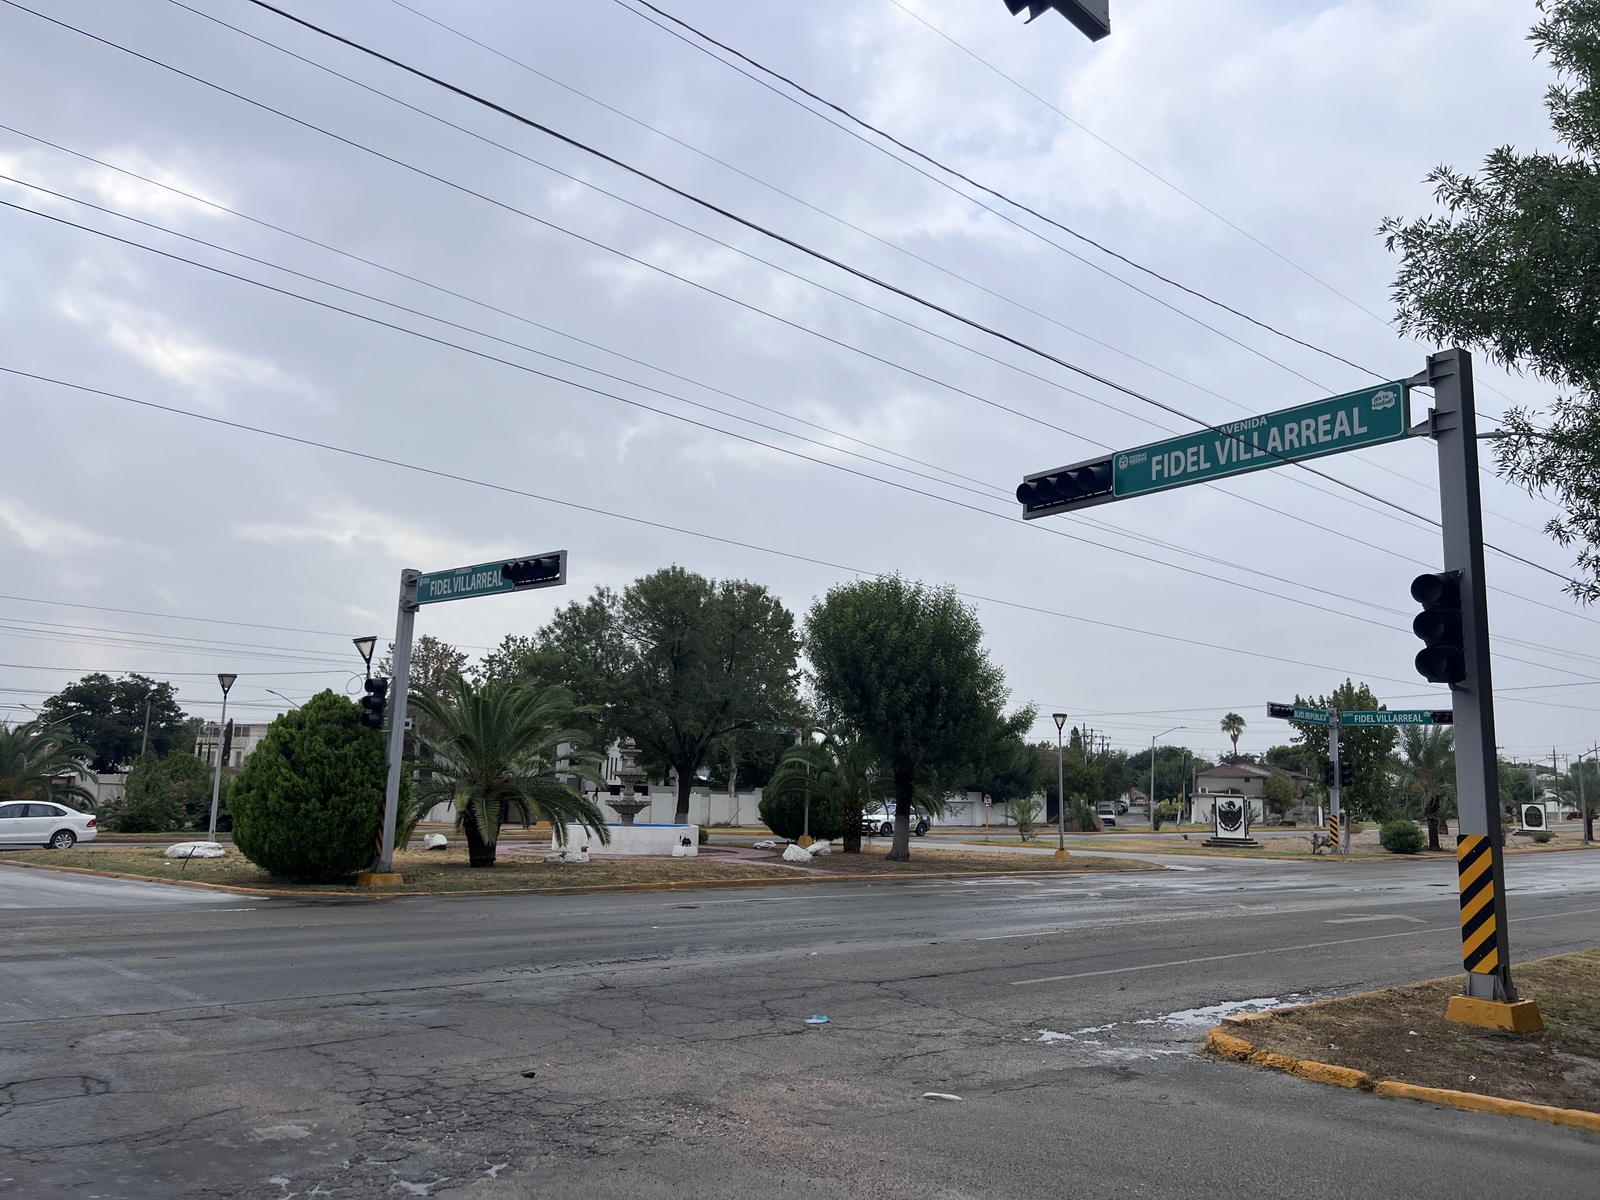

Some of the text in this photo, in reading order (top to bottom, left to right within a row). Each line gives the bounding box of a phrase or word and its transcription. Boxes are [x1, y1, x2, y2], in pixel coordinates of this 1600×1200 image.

[1220, 416, 1267, 436] AVENIDA
[1151, 406, 1368, 481] FIDEL VILLARREAL
[455, 567, 472, 575] AVENIDA
[430, 579, 452, 596] FIDEL
[453, 569, 503, 593] VILLARREAL
[1354, 714, 1375, 723] FIDEL
[1376, 713, 1423, 723] VILLARREAL
